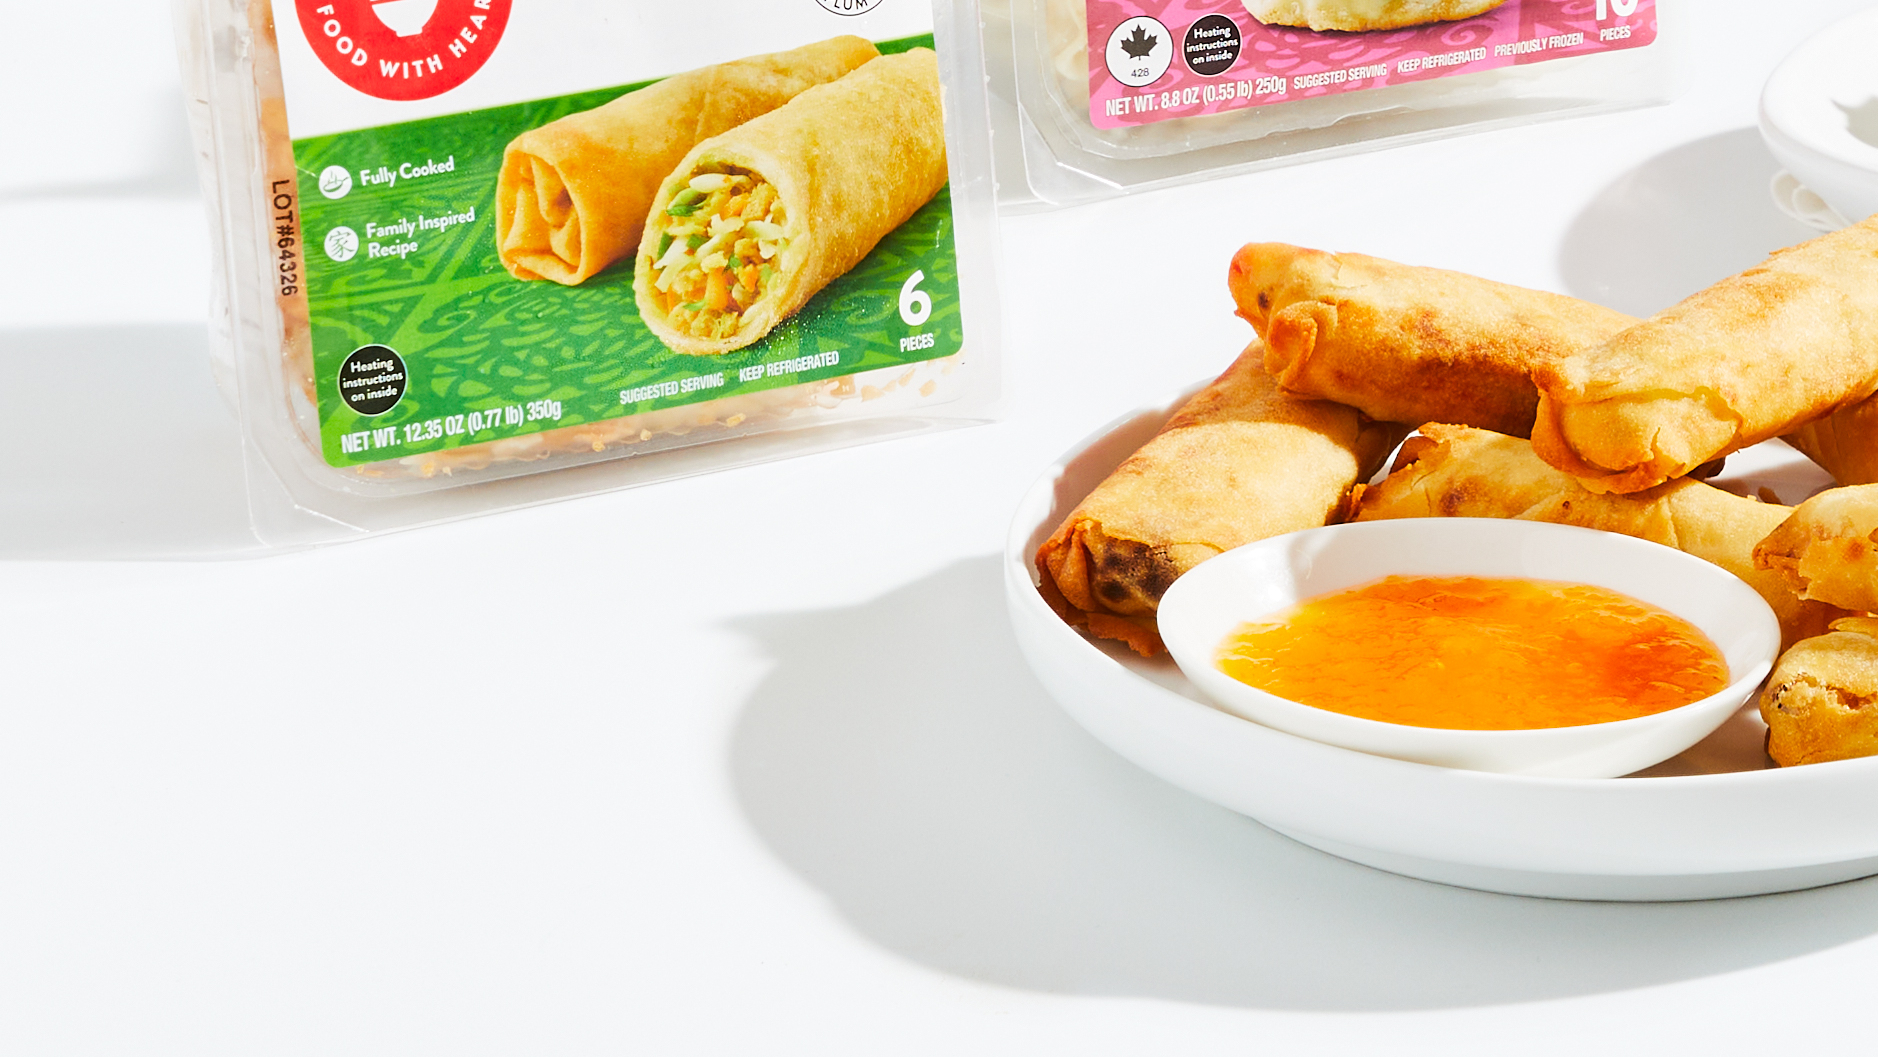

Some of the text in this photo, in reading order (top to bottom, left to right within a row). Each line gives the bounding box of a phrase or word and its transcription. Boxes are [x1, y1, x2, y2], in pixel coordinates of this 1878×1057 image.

[317, 4, 368, 66] FOOD
[380, 54, 443, 79] WITH
[1186, 38, 1239, 53] instructions
[1193, 26, 1231, 39] Heating
[1494, 31, 1584, 57] PREVIOUSLY FROZEN
[1600, 25, 1632, 42] PIECES
[1192, 50, 1233, 65] on inside
[1398, 47, 1486, 74] KEEP REFRIGERATED
[1131, 68, 1149, 78] 428
[1294, 63, 1387, 90] SUGGESTED SERVING
[1105, 76, 1287, 116] NET WT. 8.8 OZ (0.55 lb) 250g
[360, 155, 455, 187] Fully Cooked
[366, 206, 475, 238] Family Inspired
[272, 179, 298, 296] LOT#64326
[368, 239, 418, 260] Recipe
[899, 269, 932, 327] 6
[900, 333, 935, 353] PIECES
[350, 358, 394, 373] Heating
[739, 350, 840, 383] KEEP REFRIGERATED
[343, 372, 404, 389] instructions
[351, 385, 398, 402] on inside
[620, 372, 724, 405] SUGGESTED SERVING
[341, 399, 562, 454] NET WT. 12.35 OZ (0.77 lb) 350g
